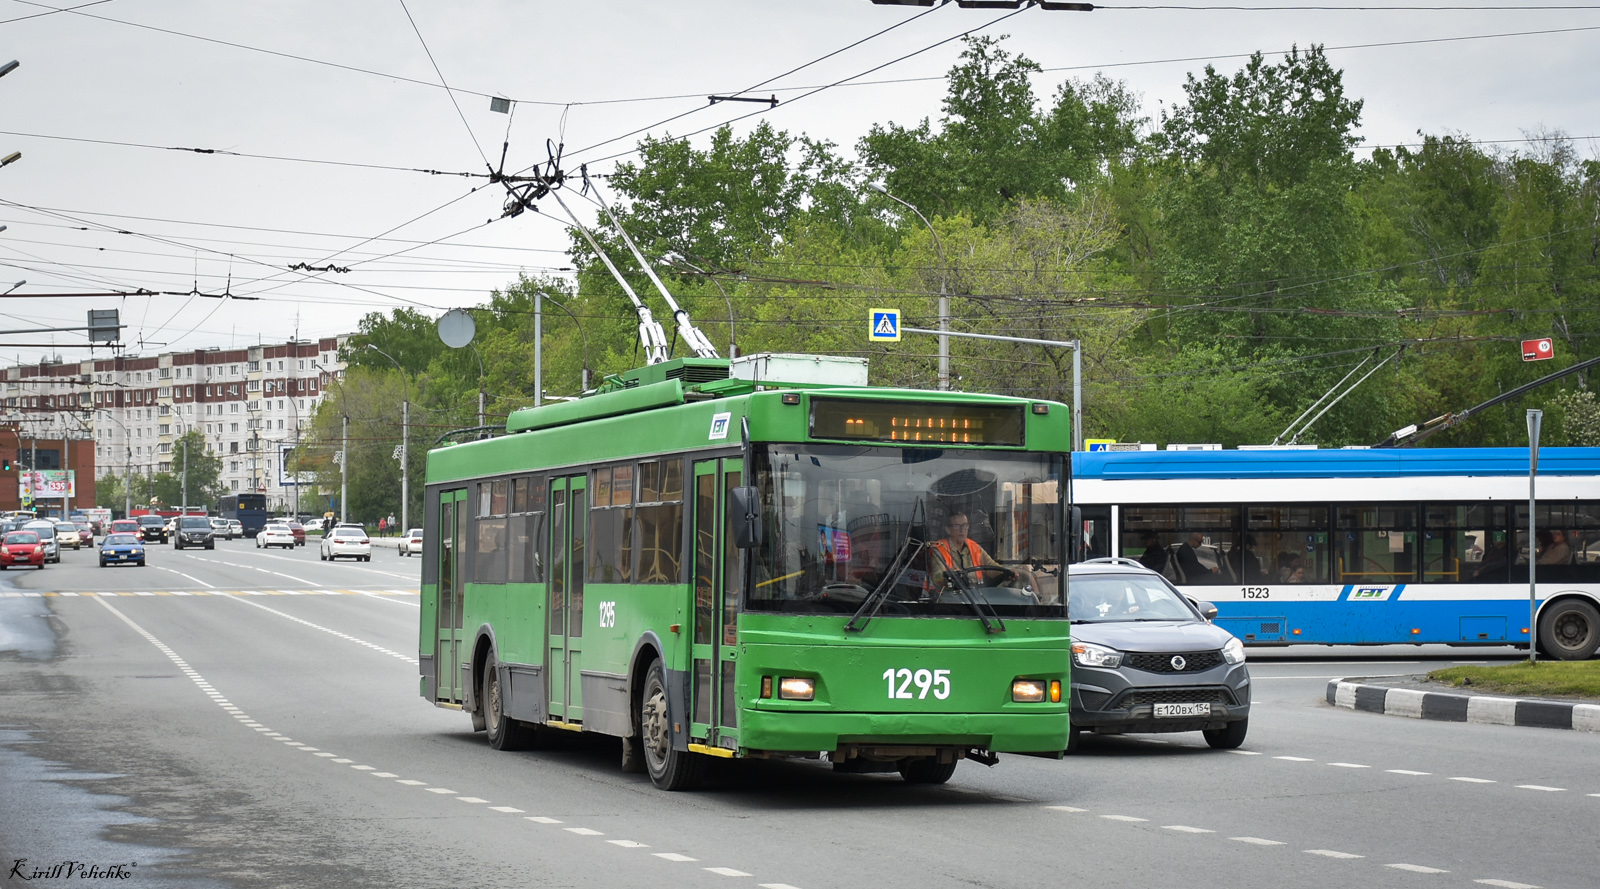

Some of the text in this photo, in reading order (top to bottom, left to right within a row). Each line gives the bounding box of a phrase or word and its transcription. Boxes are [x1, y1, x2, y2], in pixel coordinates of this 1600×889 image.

[1241, 587, 1270, 599] 1523
[599, 601, 616, 628] 1295
[883, 668, 951, 700] 1295
